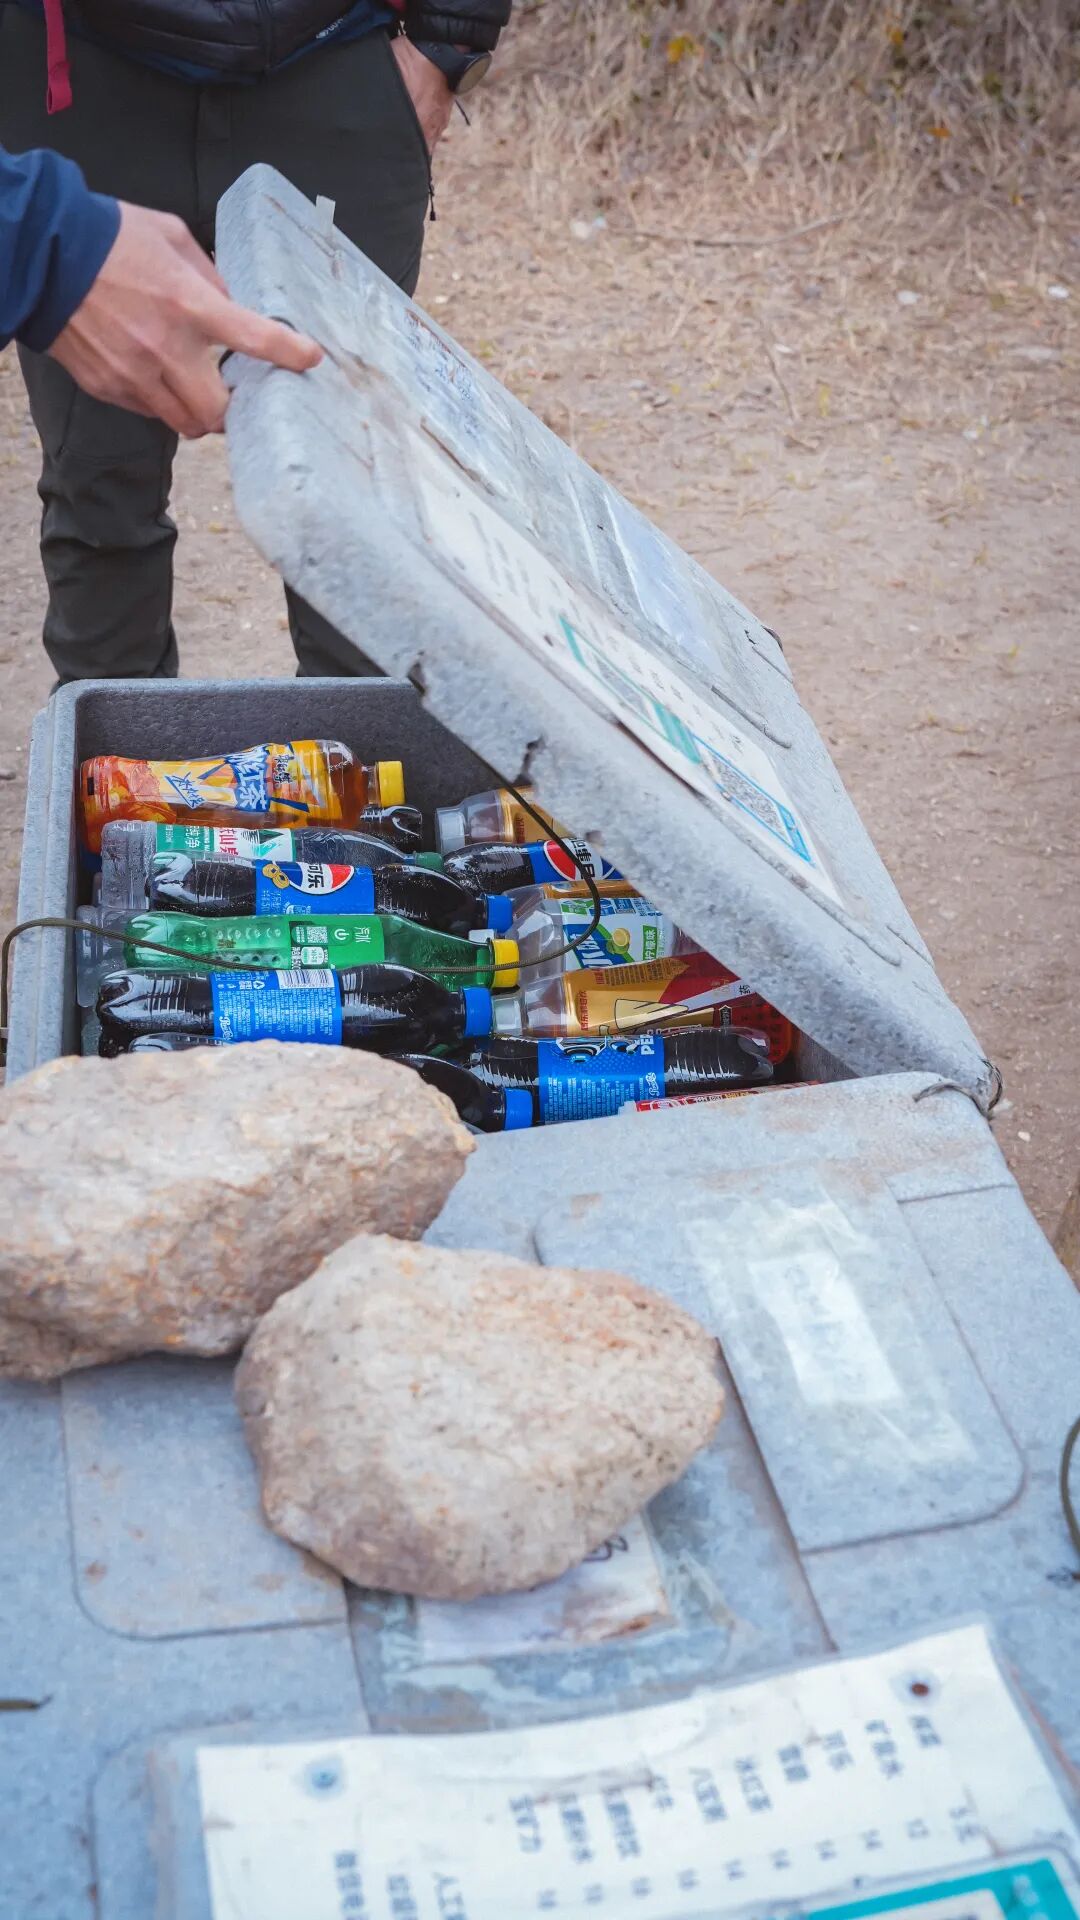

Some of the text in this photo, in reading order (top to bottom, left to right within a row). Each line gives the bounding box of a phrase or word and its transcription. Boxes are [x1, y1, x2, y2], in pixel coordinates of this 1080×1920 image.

[226, 745, 268, 809] 冰红茶
[644, 929, 656, 960] 柠檬味
